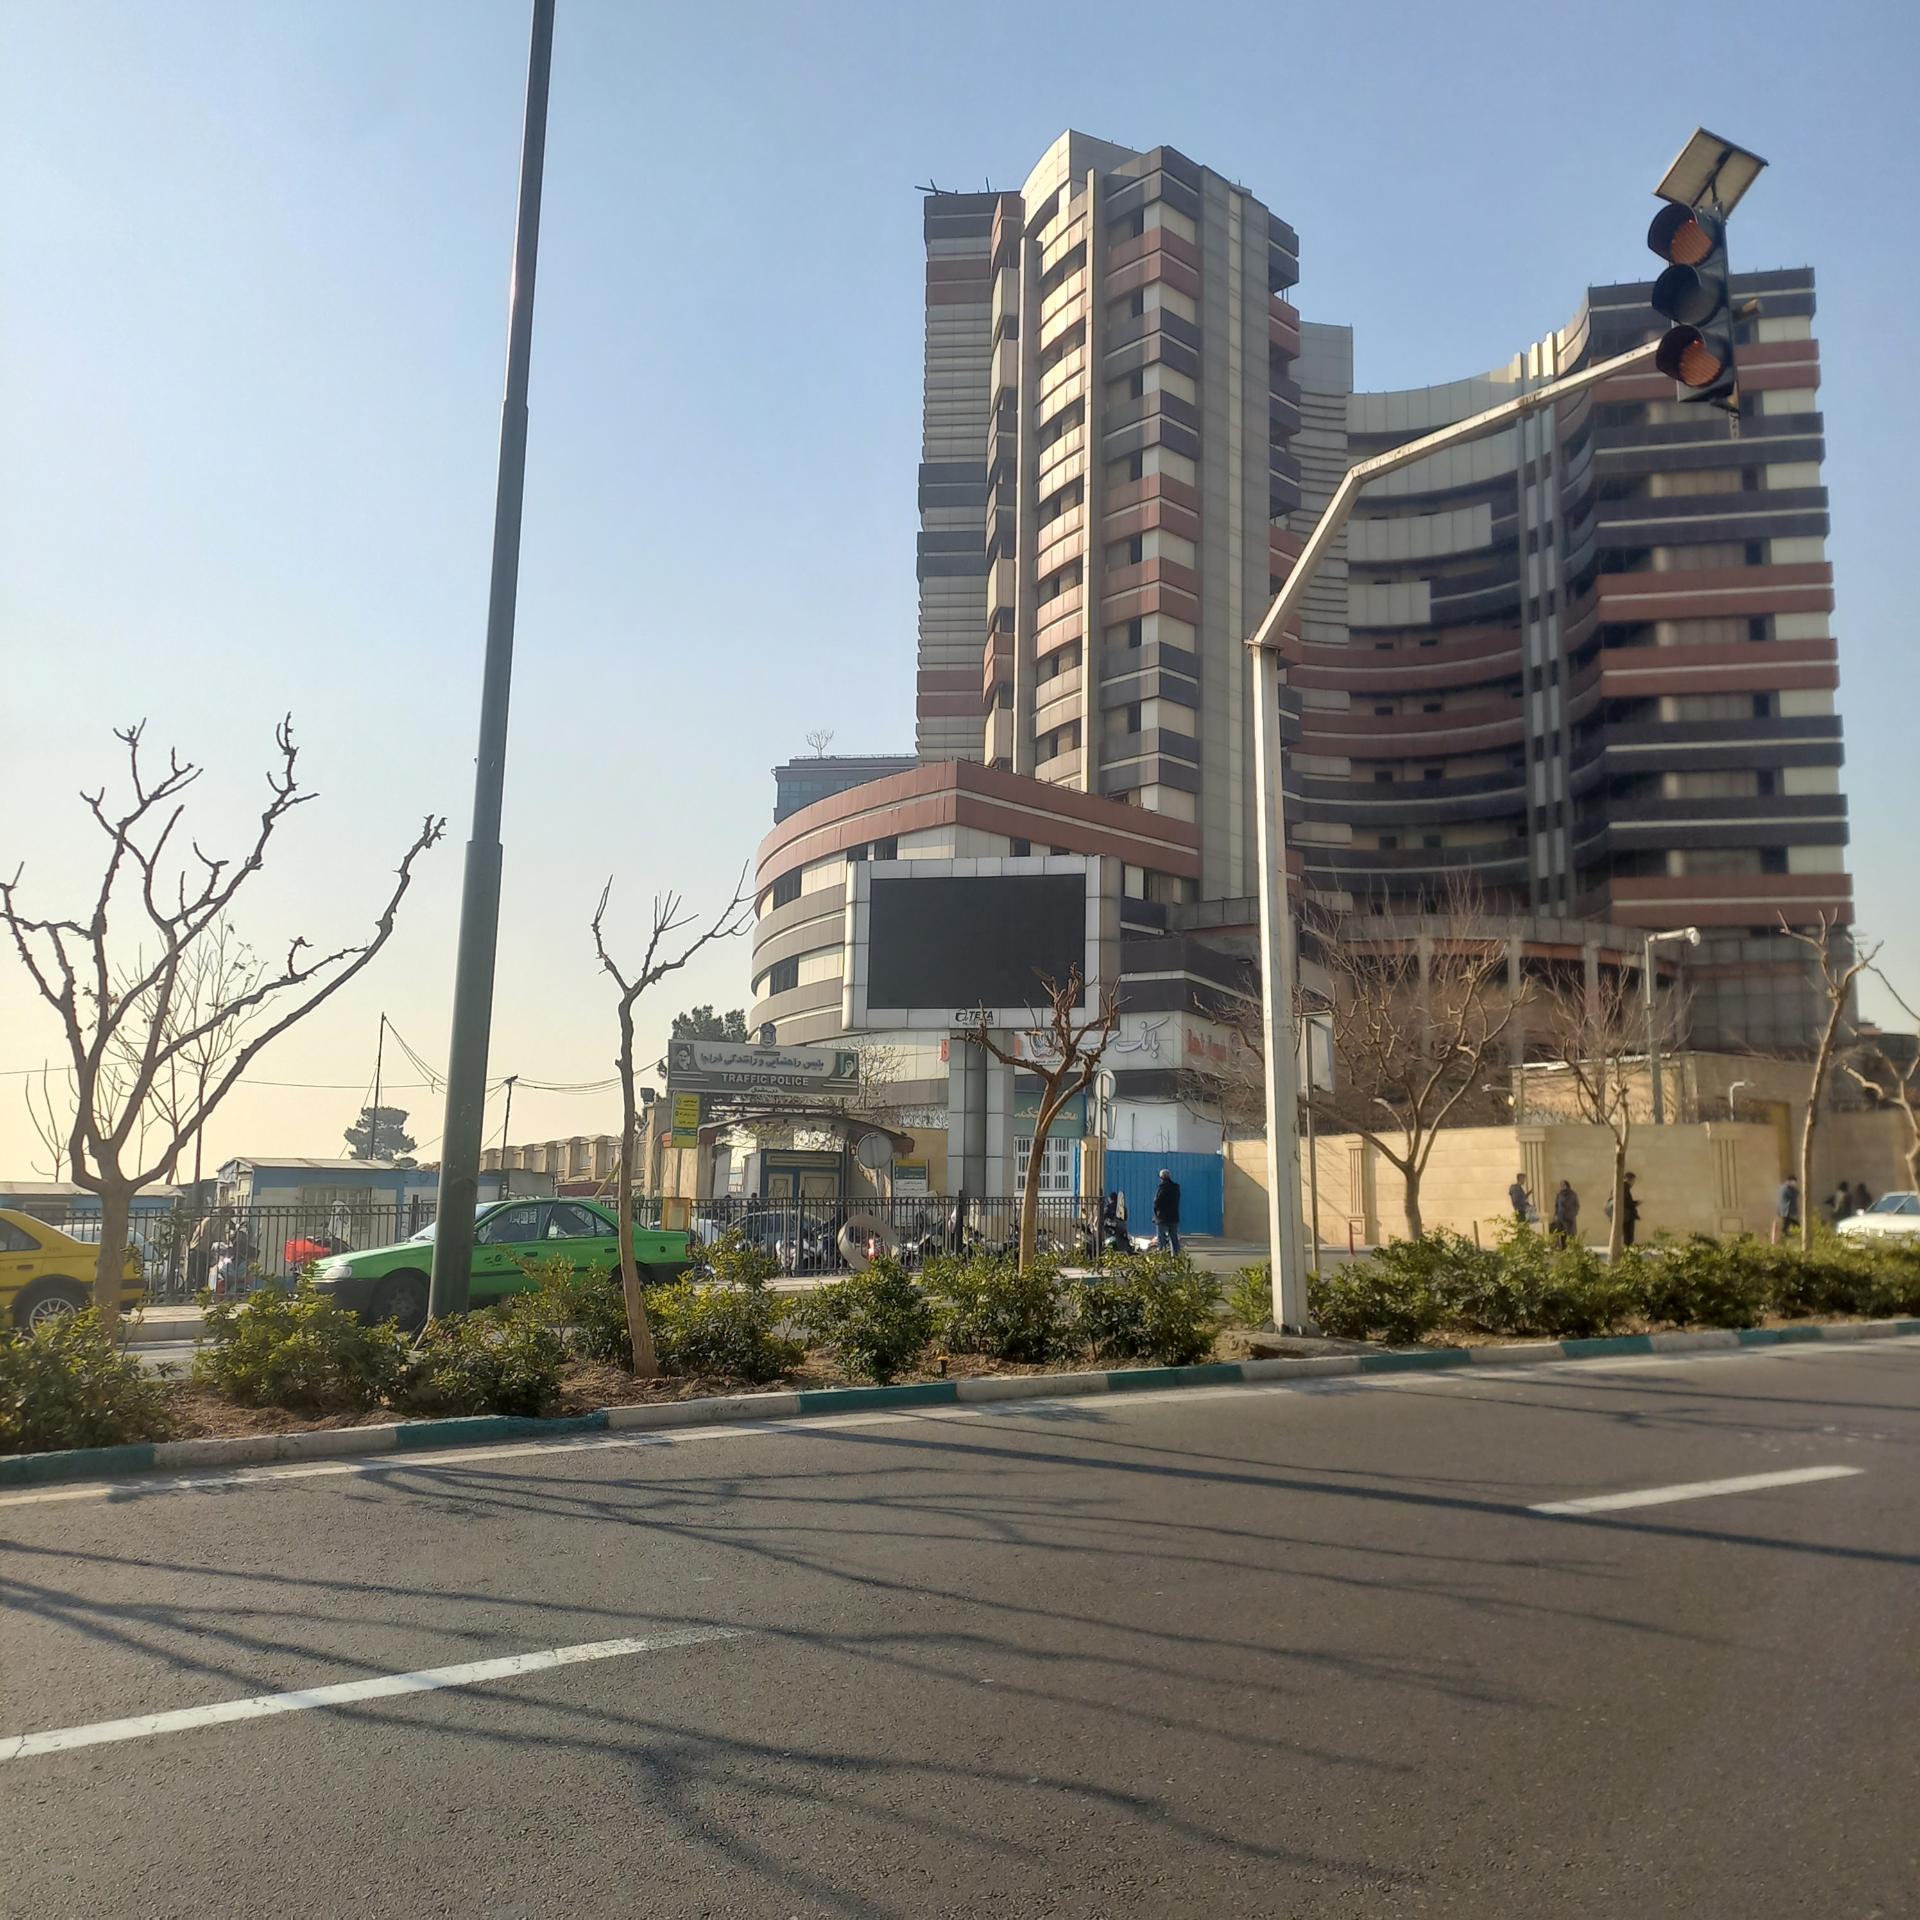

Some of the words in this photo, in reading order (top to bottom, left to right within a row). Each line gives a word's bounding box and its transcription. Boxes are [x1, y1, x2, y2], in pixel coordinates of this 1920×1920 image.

[1115, 1016, 1170, 1059] بانک
[700, 1052, 724, 1065] فراجا
[723, 1054, 758, 1066] رانندگی
[765, 1056, 802, 1069] راهنمایی
[803, 1058, 825, 1071] پلیس
[721, 1073, 769, 1085] TRAFFIC
[770, 1074, 809, 1086] POLICE
